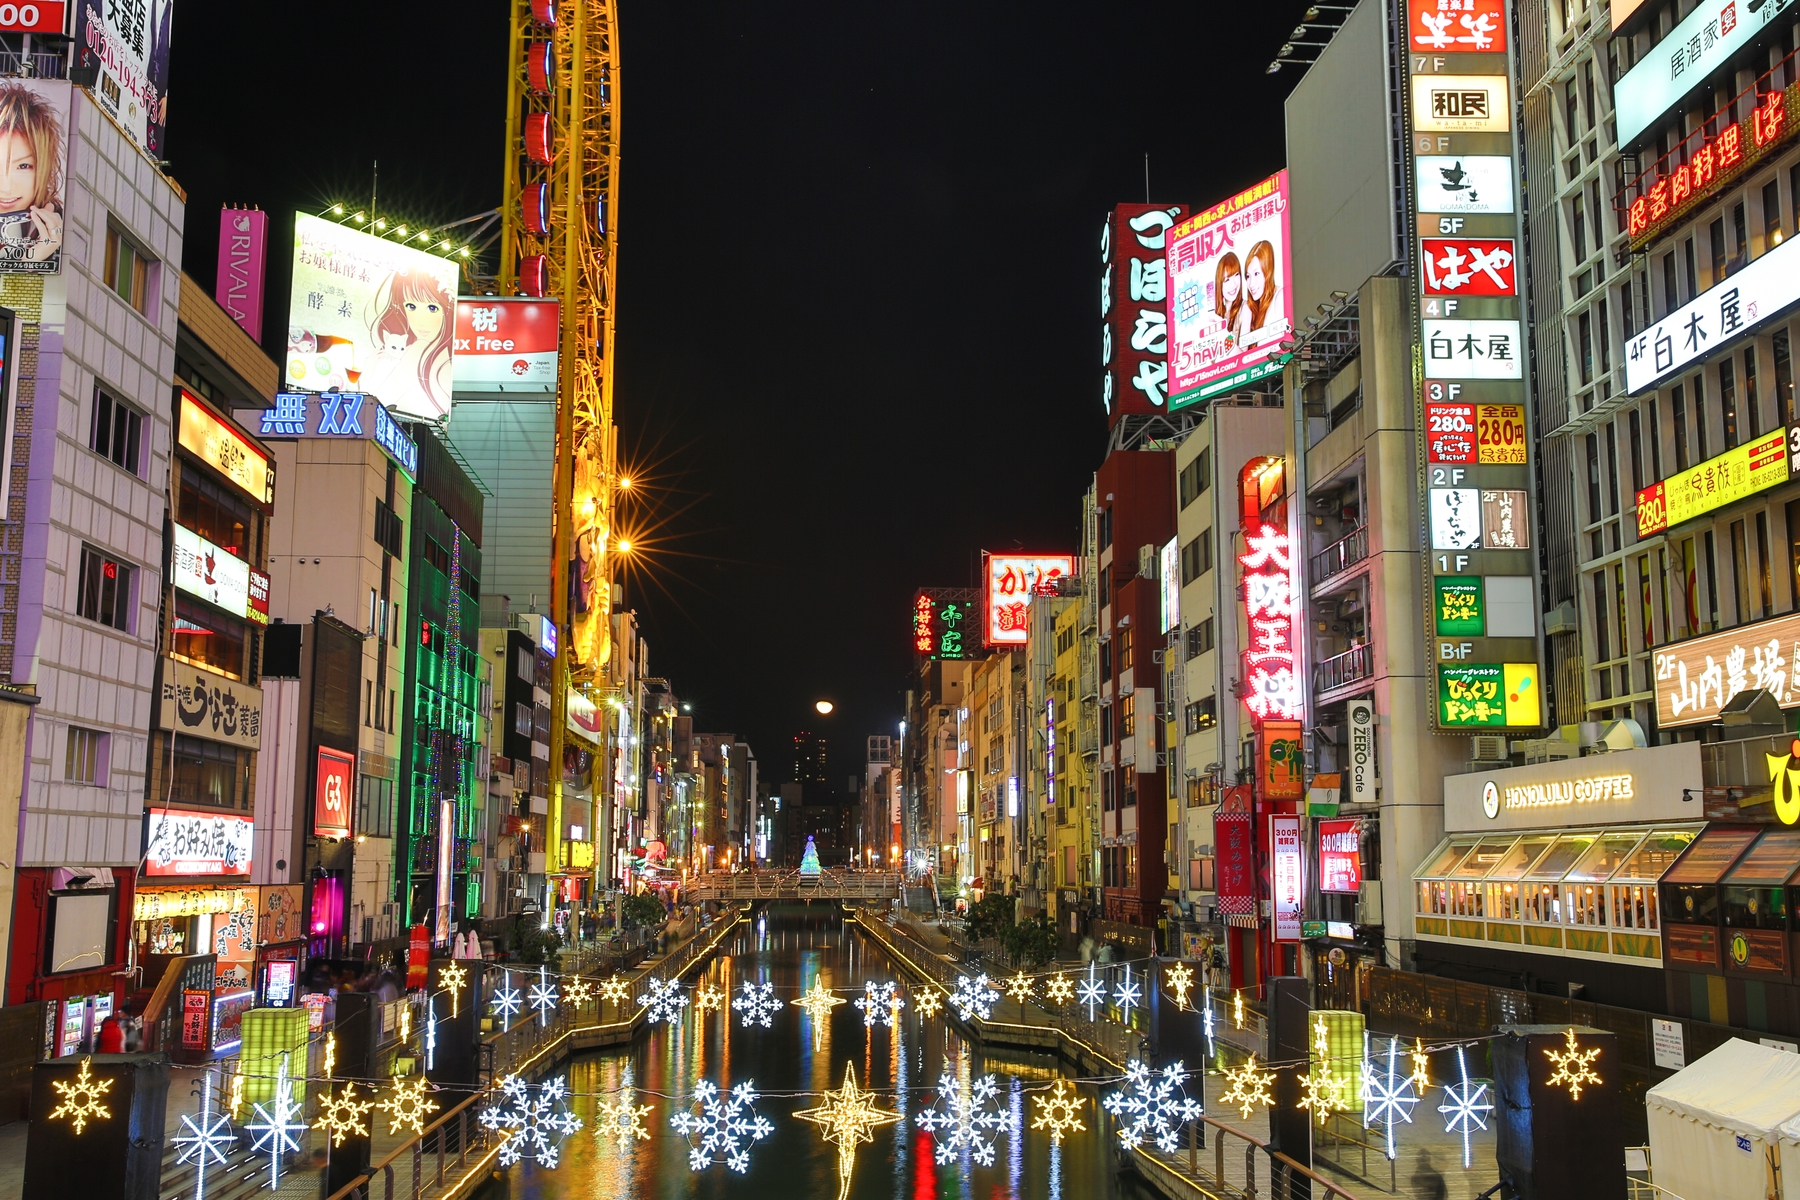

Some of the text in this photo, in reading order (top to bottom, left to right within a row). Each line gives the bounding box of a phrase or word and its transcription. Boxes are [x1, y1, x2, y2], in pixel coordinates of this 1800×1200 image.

[1671, 18, 1719, 81] 居酒家
[1434, 92, 1486, 116] 和民
[1177, 223, 1235, 273] 高収入
[1230, 199, 1286, 234] お仕事探し
[1440, 218, 1464, 234] 5F
[4, 247, 35, 259] YOU
[299, 249, 371, 283] お嬢様酵素
[1424, 246, 1513, 291] はや
[476, 336, 515, 351] Free
[1430, 330, 1514, 360] 白木屋
[1655, 286, 1744, 374] 白木屋
[1631, 336, 1647, 362] 4F
[260, 393, 364, 434] 無双
[1429, 415, 1473, 432] 280円
[1430, 407, 1471, 415] ドリンク全品
[1481, 405, 1518, 418] 全品
[1479, 419, 1524, 445] 280円
[1480, 448, 1526, 462] 鳥貴族
[1483, 492, 1497, 502] 2F
[1499, 492, 1516, 548] 山内農場
[1638, 497, 1666, 531] 280円
[1442, 607, 1478, 620] ドンキー
[1443, 591, 1475, 606] びっくり
[916, 594, 932, 652] お好み焼
[941, 603, 963, 653] 千房
[1239, 524, 1293, 719] 大阪王将
[1440, 643, 1472, 659] B1F
[1656, 653, 1676, 680] 2F
[1670, 638, 1787, 717] 山内農場
[1447, 676, 1497, 701] びっくり
[178, 675, 239, 736] うなぎ
[1445, 700, 1502, 722] ドンキー
[1354, 727, 1367, 793] ZERO cafe
[325, 774, 341, 812] G3
[1505, 774, 1633, 808] HONOLULU COFFEE
[174, 818, 225, 858] お好み焼
[1276, 829, 1299, 837] 300円
[1228, 823, 1243, 888] 大阪みやげ
